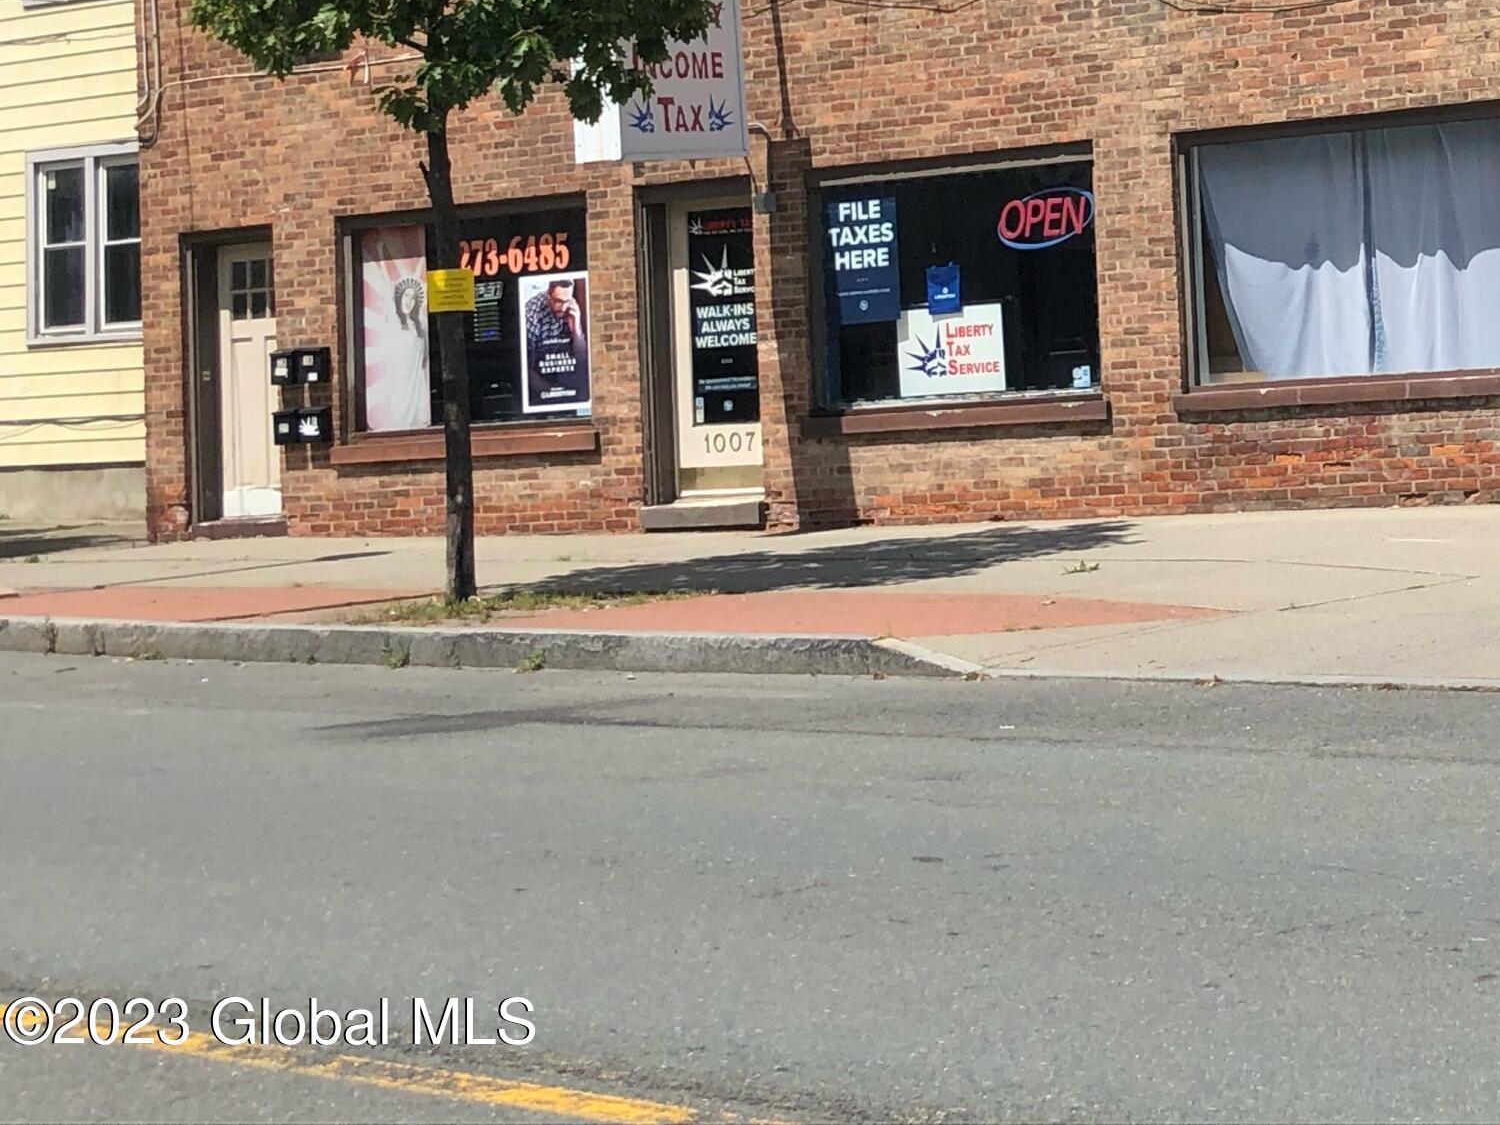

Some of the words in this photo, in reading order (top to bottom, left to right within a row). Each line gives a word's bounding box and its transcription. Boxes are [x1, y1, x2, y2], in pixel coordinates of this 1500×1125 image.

[657, 96, 705, 132] TAX
[839, 199, 881, 222] FILE
[1000, 196, 1086, 239] OPEN
[828, 222, 894, 247] TAXES
[459, 232, 570, 276] 273-6485
[835, 247, 890, 271] HERE
[696, 303, 754, 318] WALK-INS
[701, 318, 750, 334] ALWAYS
[946, 322, 994, 339] LIBERTY
[695, 333, 757, 349] WELCOME
[946, 341, 971, 357] TAX
[948, 359, 1000, 375] SERVICE
[704, 431, 755, 453] 1007
